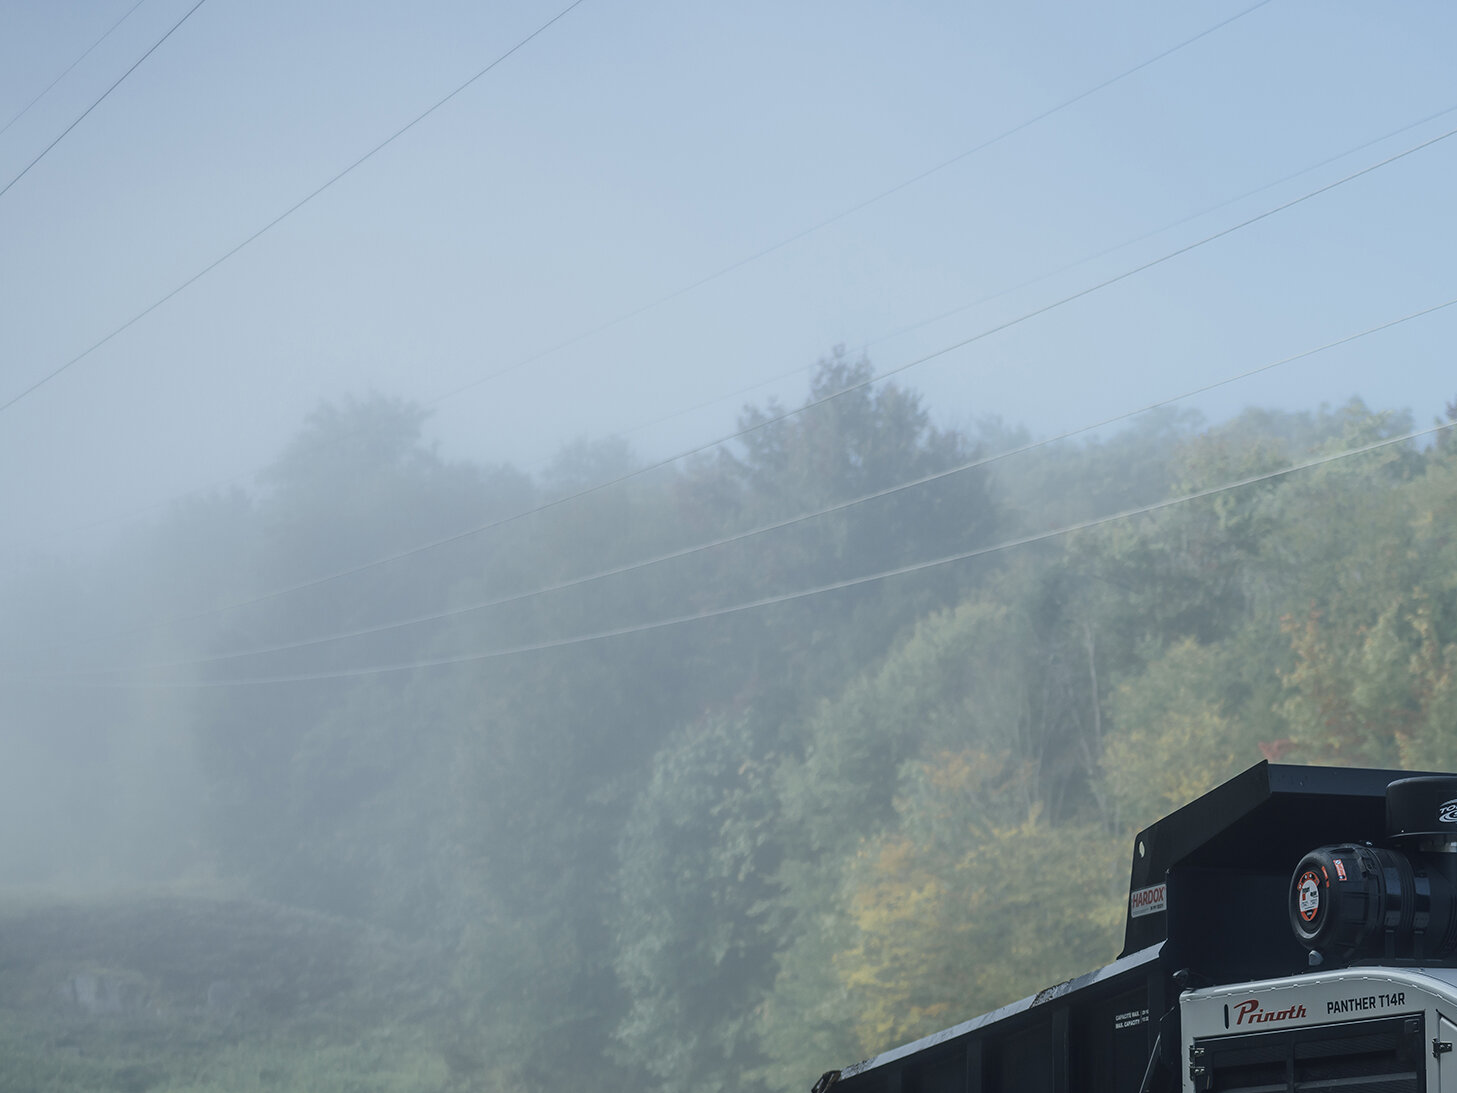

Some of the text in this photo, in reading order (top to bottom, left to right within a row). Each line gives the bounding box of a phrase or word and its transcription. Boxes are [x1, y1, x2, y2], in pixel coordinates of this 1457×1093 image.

[1132, 886, 1165, 909] HARDOX
[1233, 992, 1406, 1025] Prinoth PANTHER T14R
